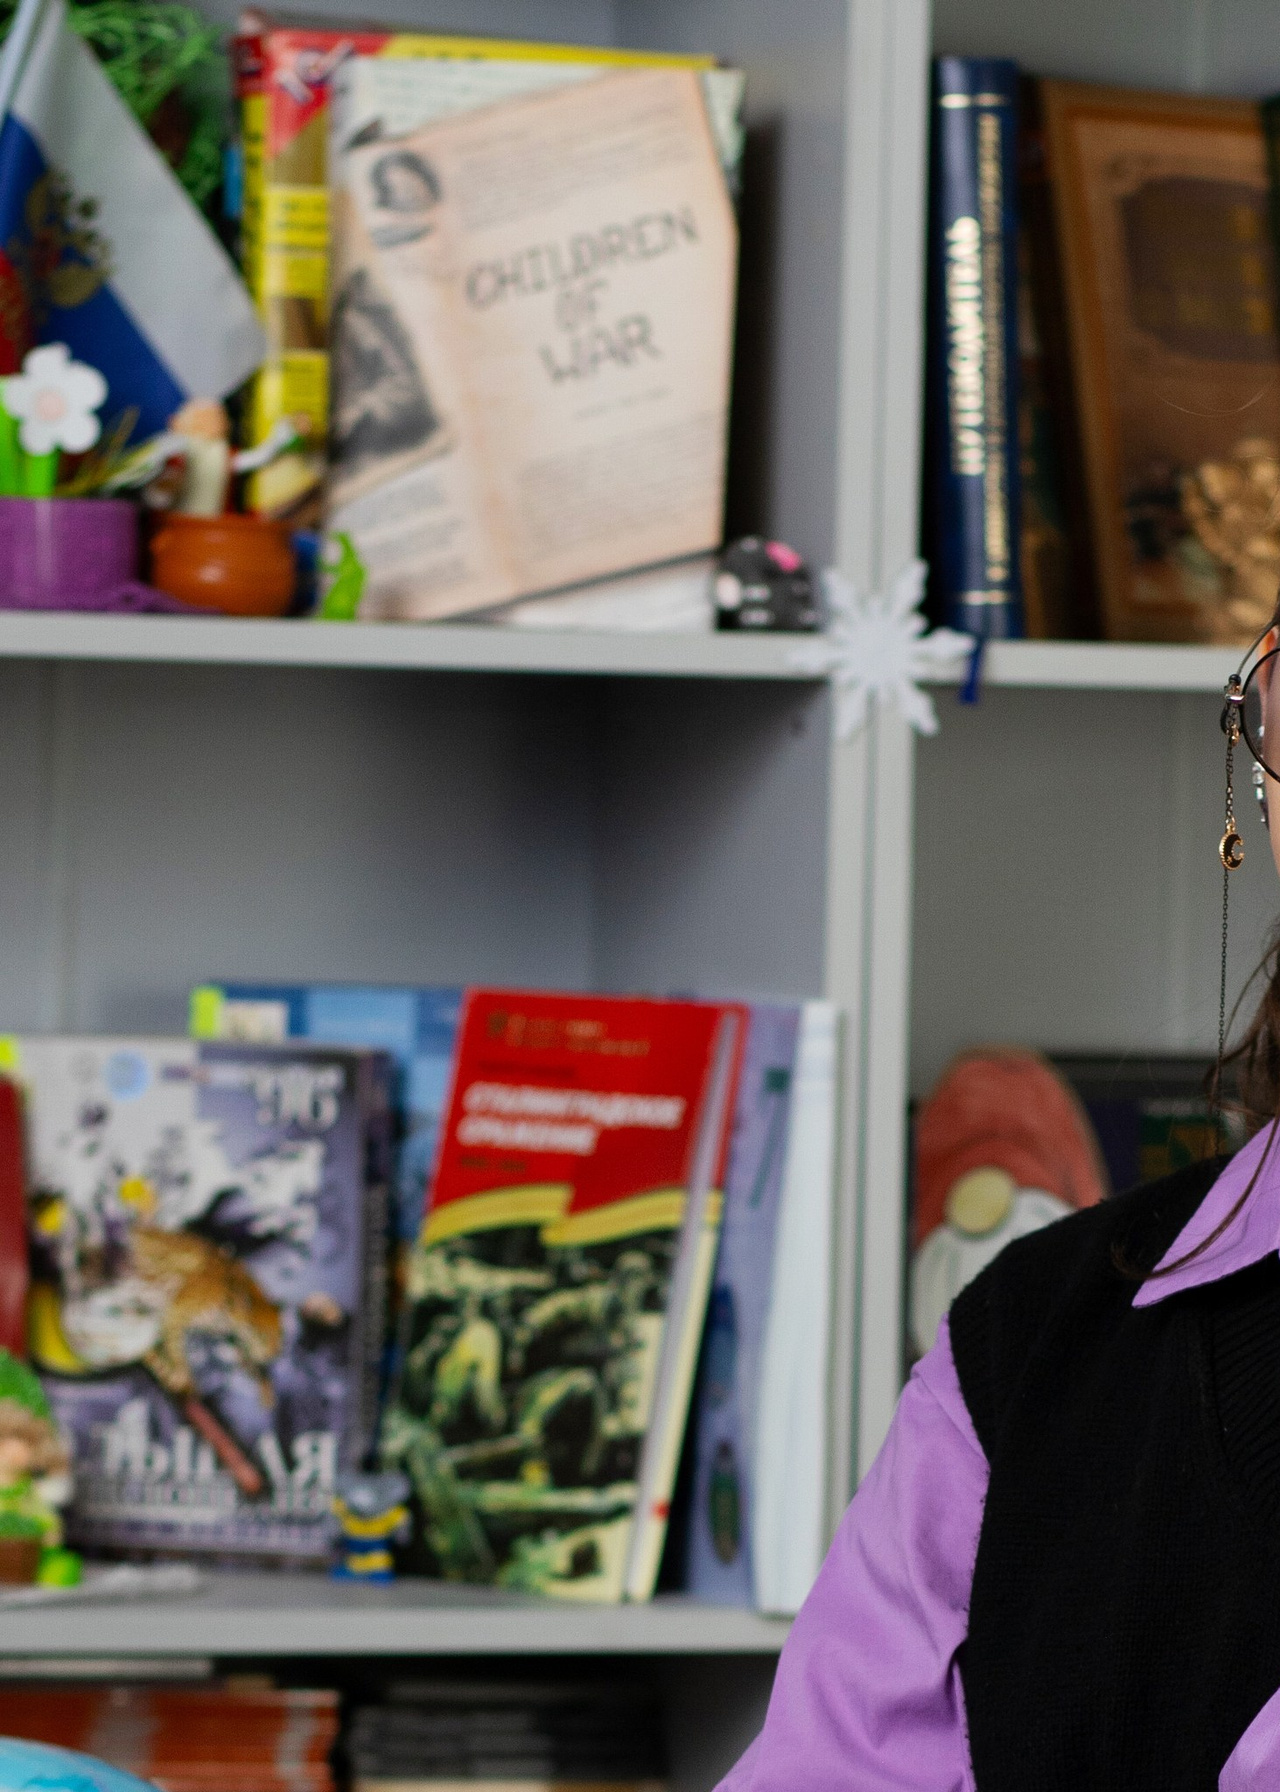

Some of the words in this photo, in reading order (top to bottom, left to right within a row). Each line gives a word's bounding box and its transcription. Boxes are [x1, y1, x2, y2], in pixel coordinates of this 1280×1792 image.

[463, 201, 700, 311] CHILDREN
[554, 277, 609, 333] OF
[536, 312, 664, 387] WAR
